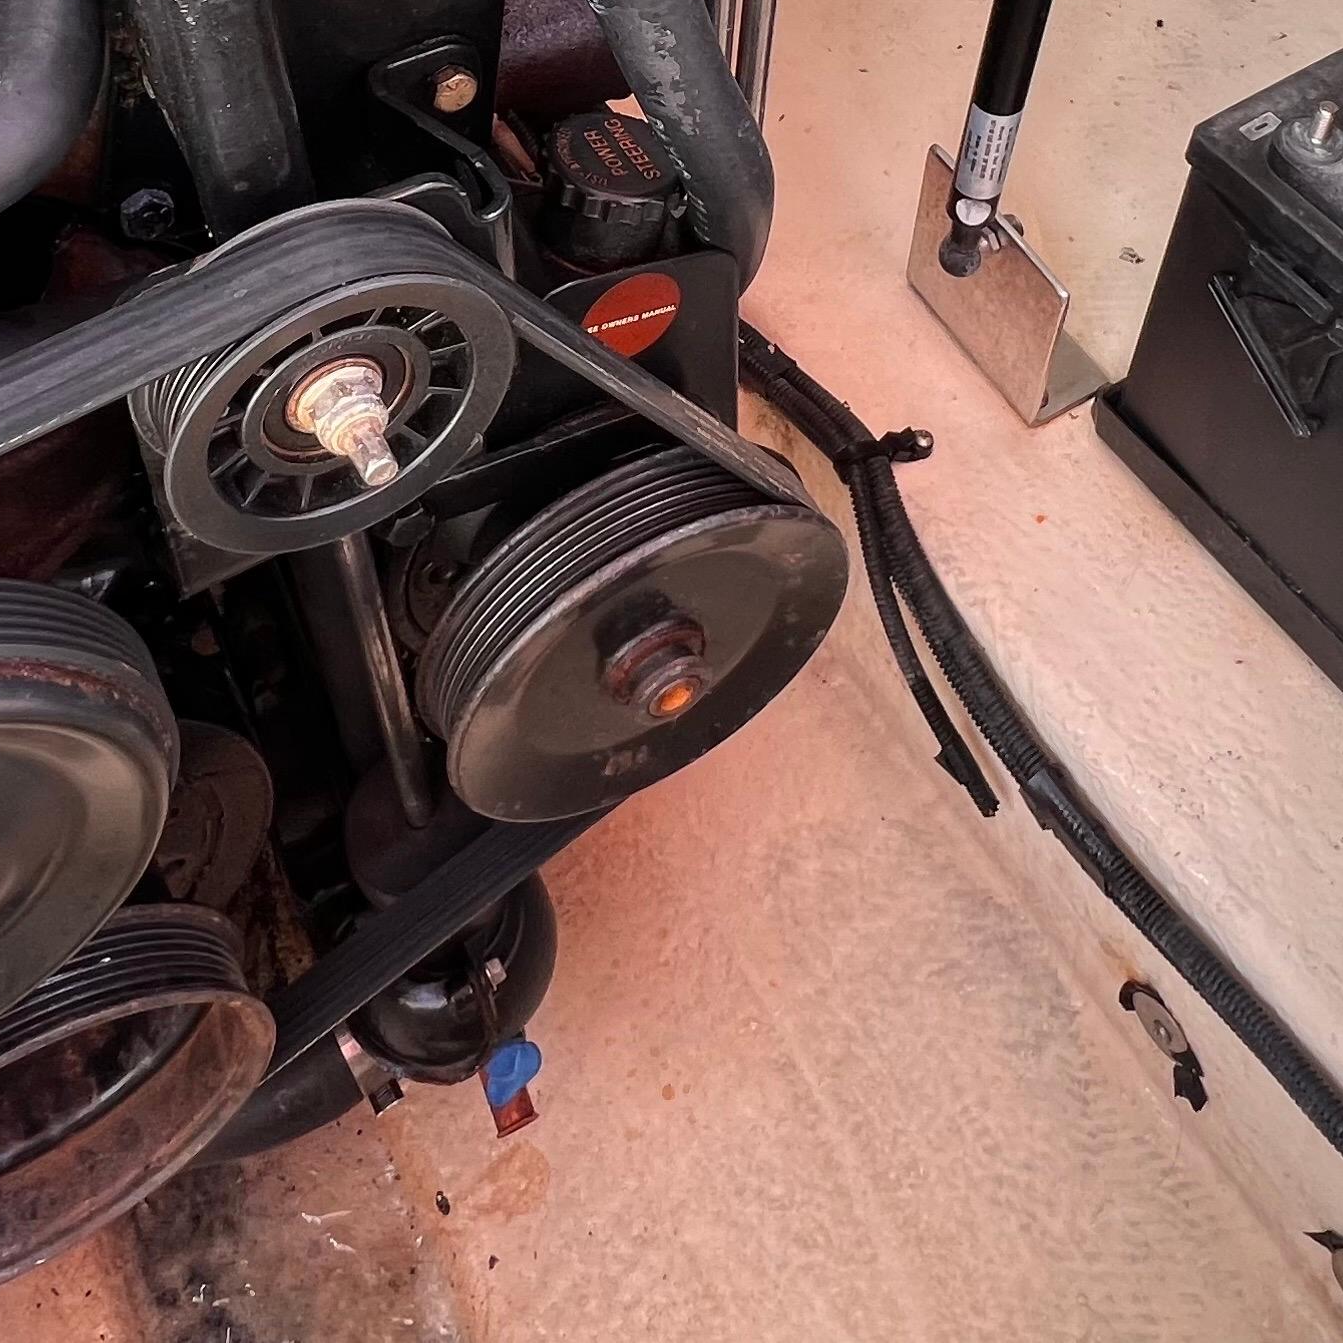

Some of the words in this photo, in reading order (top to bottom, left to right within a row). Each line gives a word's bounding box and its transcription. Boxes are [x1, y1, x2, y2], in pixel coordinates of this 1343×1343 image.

[583, 128, 629, 177] POWER
[604, 117, 662, 181] STEERING
[601, 313, 640, 332] OWNERS
[641, 304, 678, 320] MANUAL
